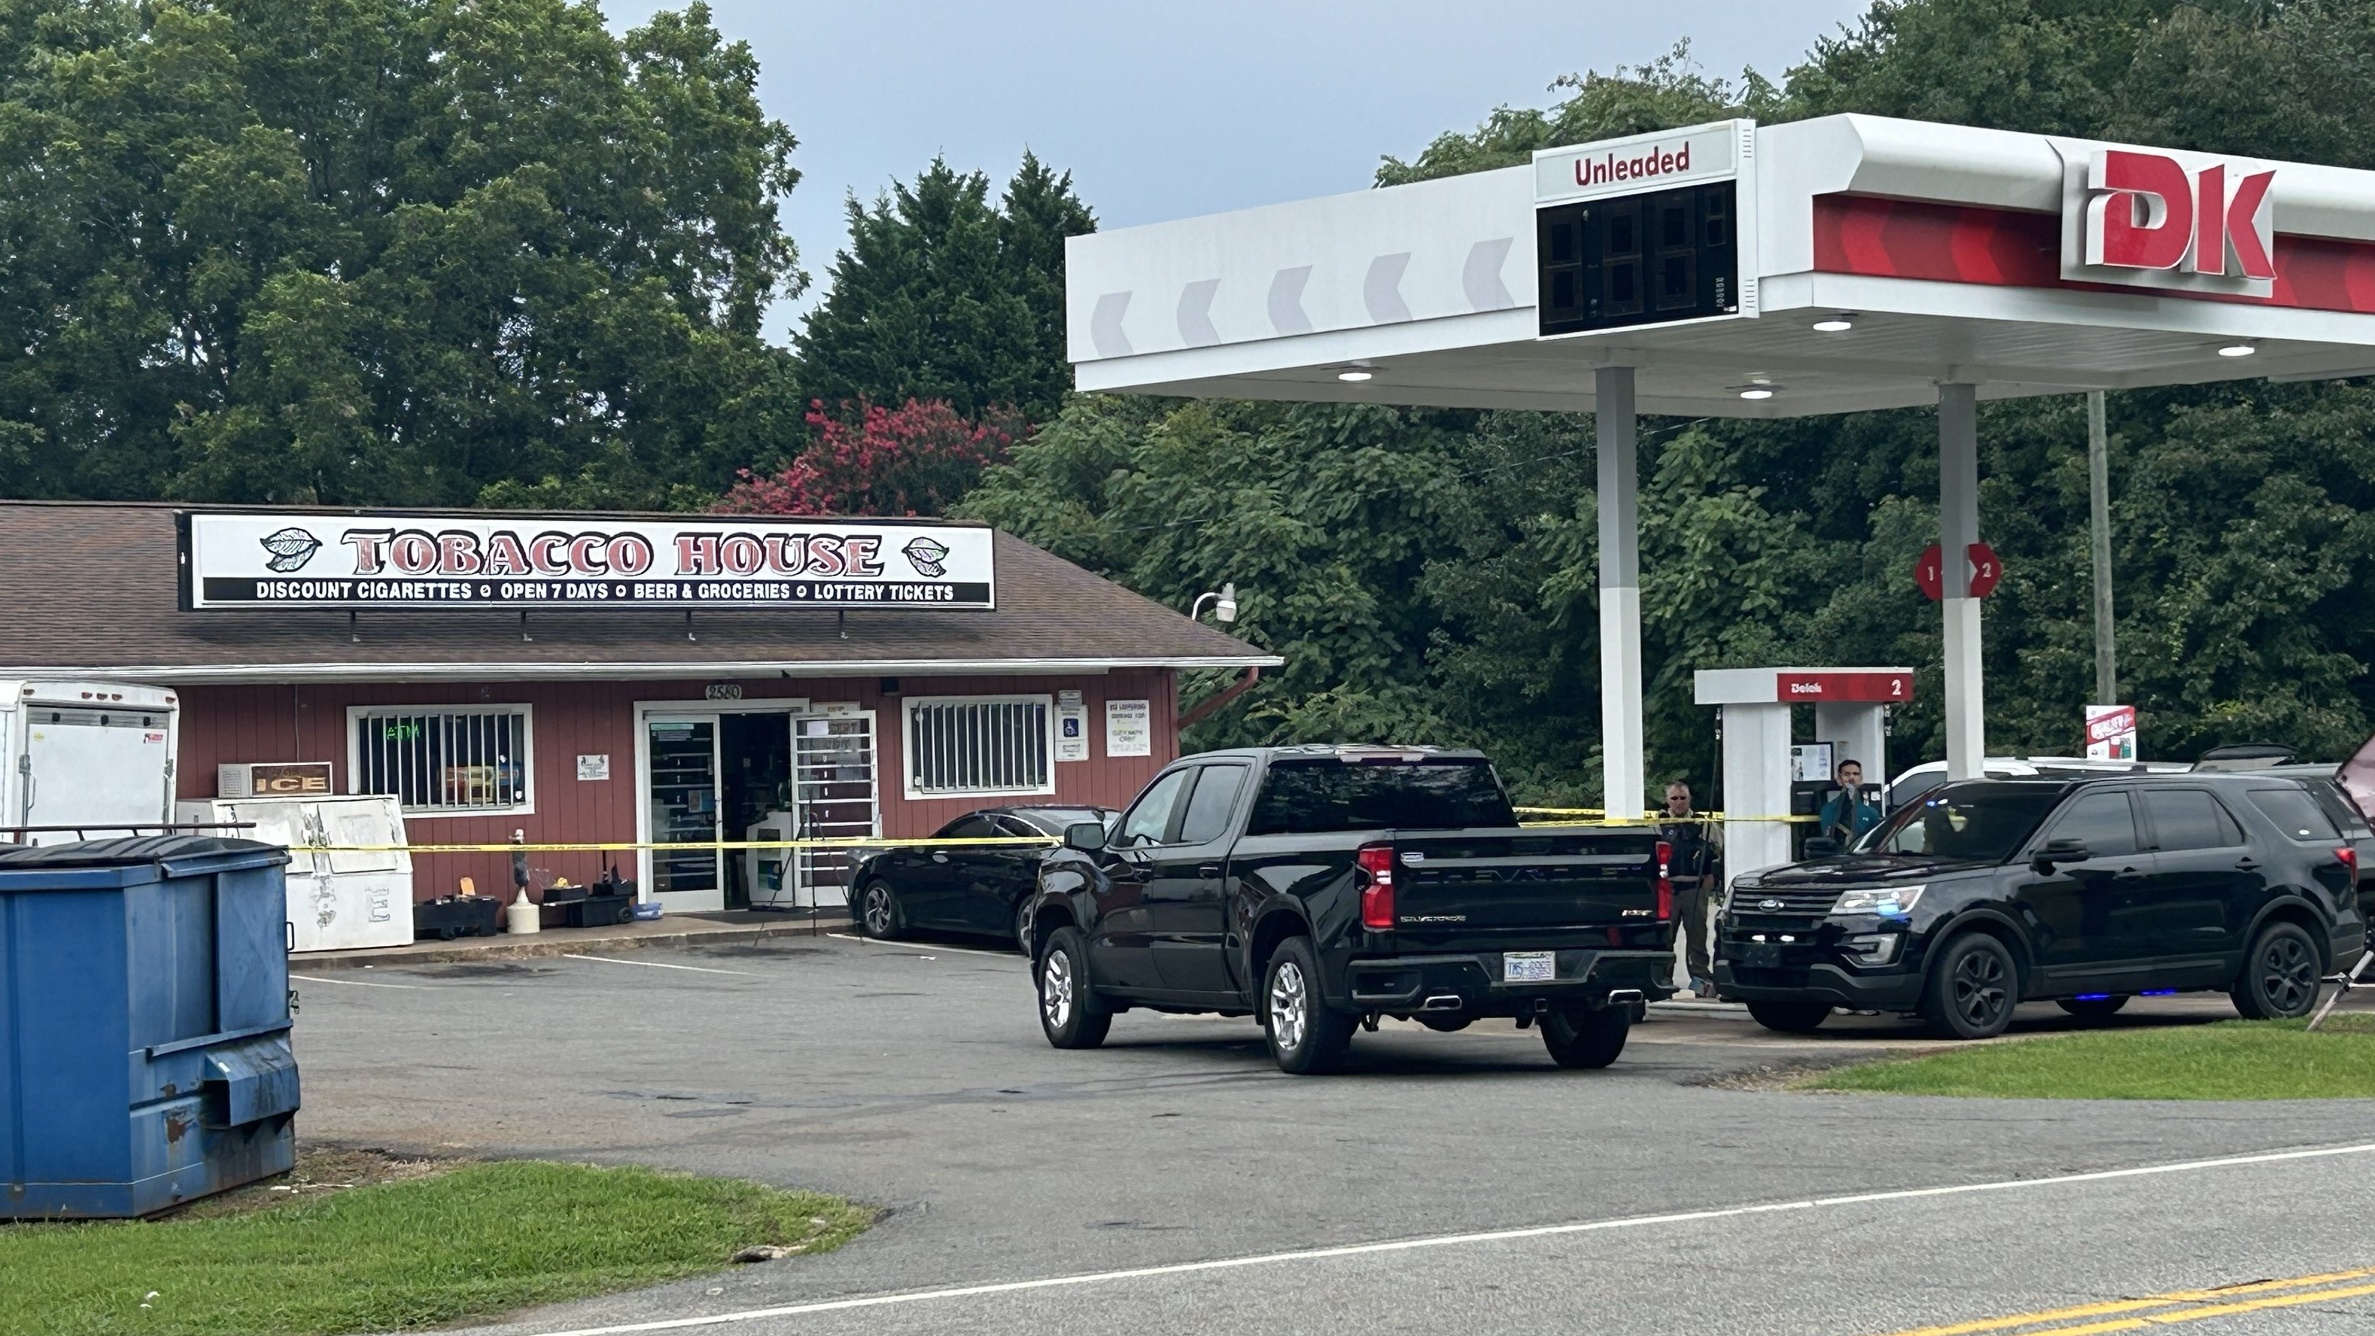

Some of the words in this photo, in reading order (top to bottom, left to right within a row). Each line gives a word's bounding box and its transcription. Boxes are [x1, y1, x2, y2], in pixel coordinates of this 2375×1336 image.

[1575, 141, 1690, 186] Unleaded
[2087, 149, 2278, 280] DK
[341, 527, 655, 577] TOBACCO
[673, 531, 885, 577] HOUSE
[1927, 566, 1934, 581] 1
[1982, 562, 1992, 578] 2
[256, 581, 352, 600] DISCOUNT
[356, 581, 472, 600] CIGARETTES
[500, 582, 547, 600] OPEN
[552, 582, 560, 599] 7
[565, 582, 608, 600] DAYS
[634, 583, 678, 600] BEER
[682, 583, 692, 599] &
[697, 583, 790, 600] GROCERIES
[813, 584, 884, 601] LOTTERY
[889, 584, 954, 601] TICKETS
[709, 685, 740, 700] 2580
[1891, 679, 1902, 696] 2
[387, 724, 420, 741] ATM
[256, 776, 328, 792] ICE
